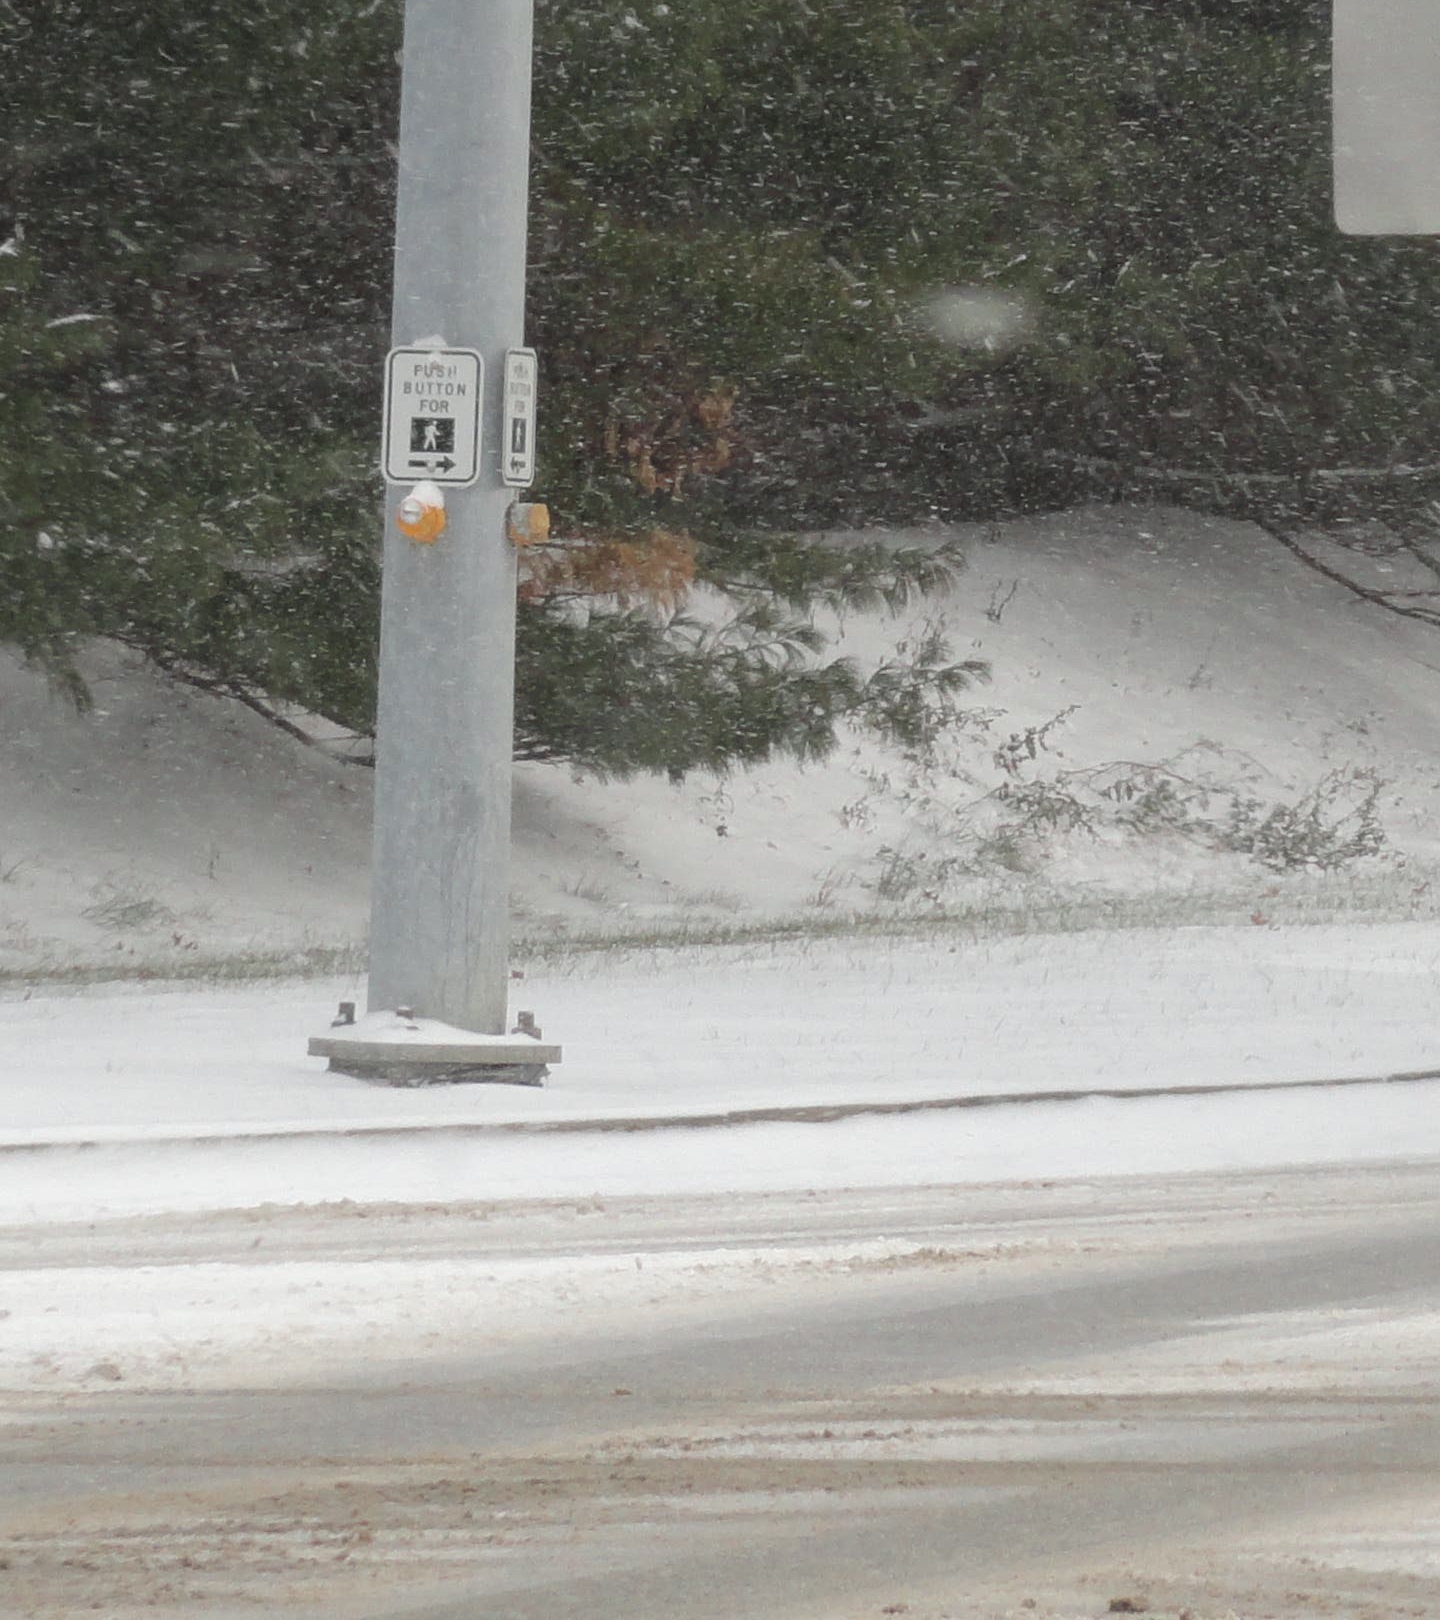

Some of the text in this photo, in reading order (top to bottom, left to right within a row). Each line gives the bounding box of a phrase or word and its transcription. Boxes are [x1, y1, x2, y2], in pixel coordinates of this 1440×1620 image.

[414, 364, 457, 378] PUSH
[403, 381, 466, 396] BUTTON
[419, 399, 449, 413] FOR
